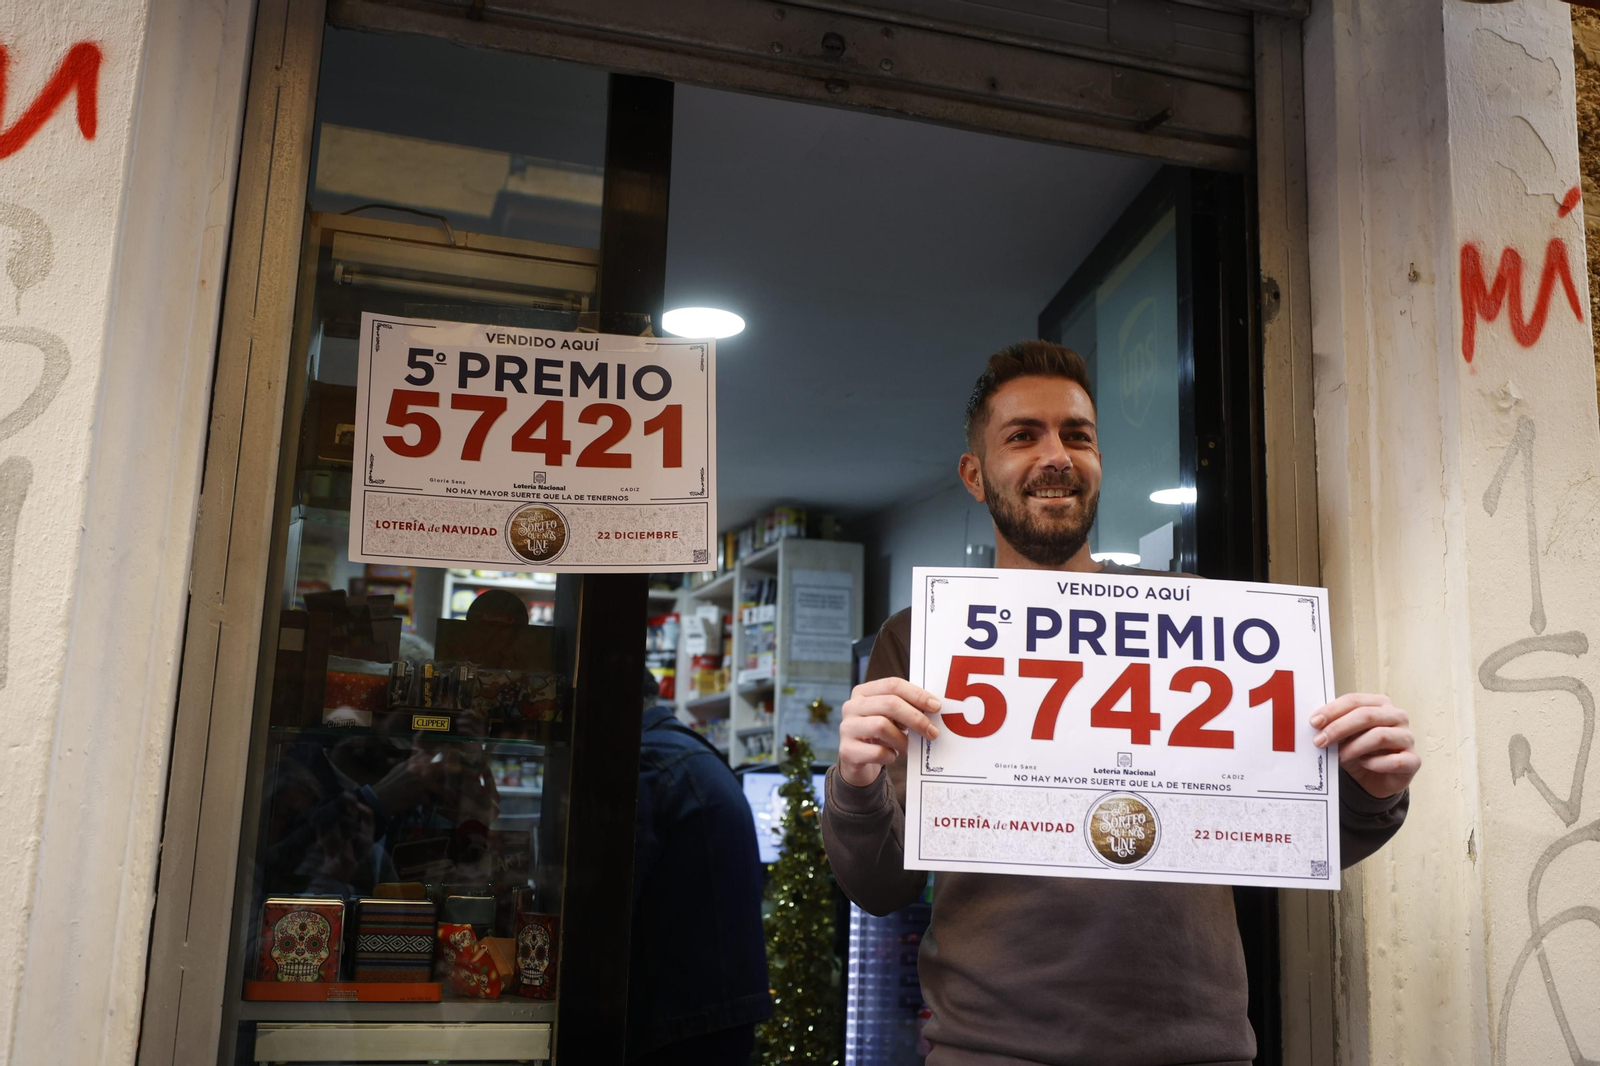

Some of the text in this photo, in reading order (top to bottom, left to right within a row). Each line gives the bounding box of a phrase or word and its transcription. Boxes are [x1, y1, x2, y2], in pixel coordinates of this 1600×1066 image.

[486, 332, 600, 351] VENDIDO AQUÍ
[404, 347, 672, 401] 5º PREMIO
[382, 388, 683, 469] 57421
[479, 489, 509, 498] MAYOR
[511, 491, 541, 499] SUERTE
[375, 519, 498, 536] LOTERÍA de NAVIDAD
[518, 520, 558, 536] SORTEO
[527, 529, 557, 541] QUE NOS
[597, 531, 679, 540] 22 DICIEMBRE
[523, 538, 549, 556] UNE
[1057, 581, 1191, 602] VENDIDO AQUÍ
[964, 604, 1280, 664] 5º PREMIO
[940, 655, 1296, 753] 57421
[326, 717, 356, 729] champ
[416, 718, 446, 728] CLIPPER
[1093, 767, 1156, 776] Lotería Nacional
[1013, 774, 1232, 792] NO HAY MAYOR SUERTE QUE LA DE TENERNOS
[934, 815, 1075, 834] LOTERÍA de NAVIDAD
[1099, 812, 1147, 833] SORTEO
[1111, 825, 1146, 840] QUE NOS
[1194, 829, 1292, 844] 22 DICIEMBRE
[1106, 836, 1137, 858] UNE
[496, 851, 525, 872] ART
